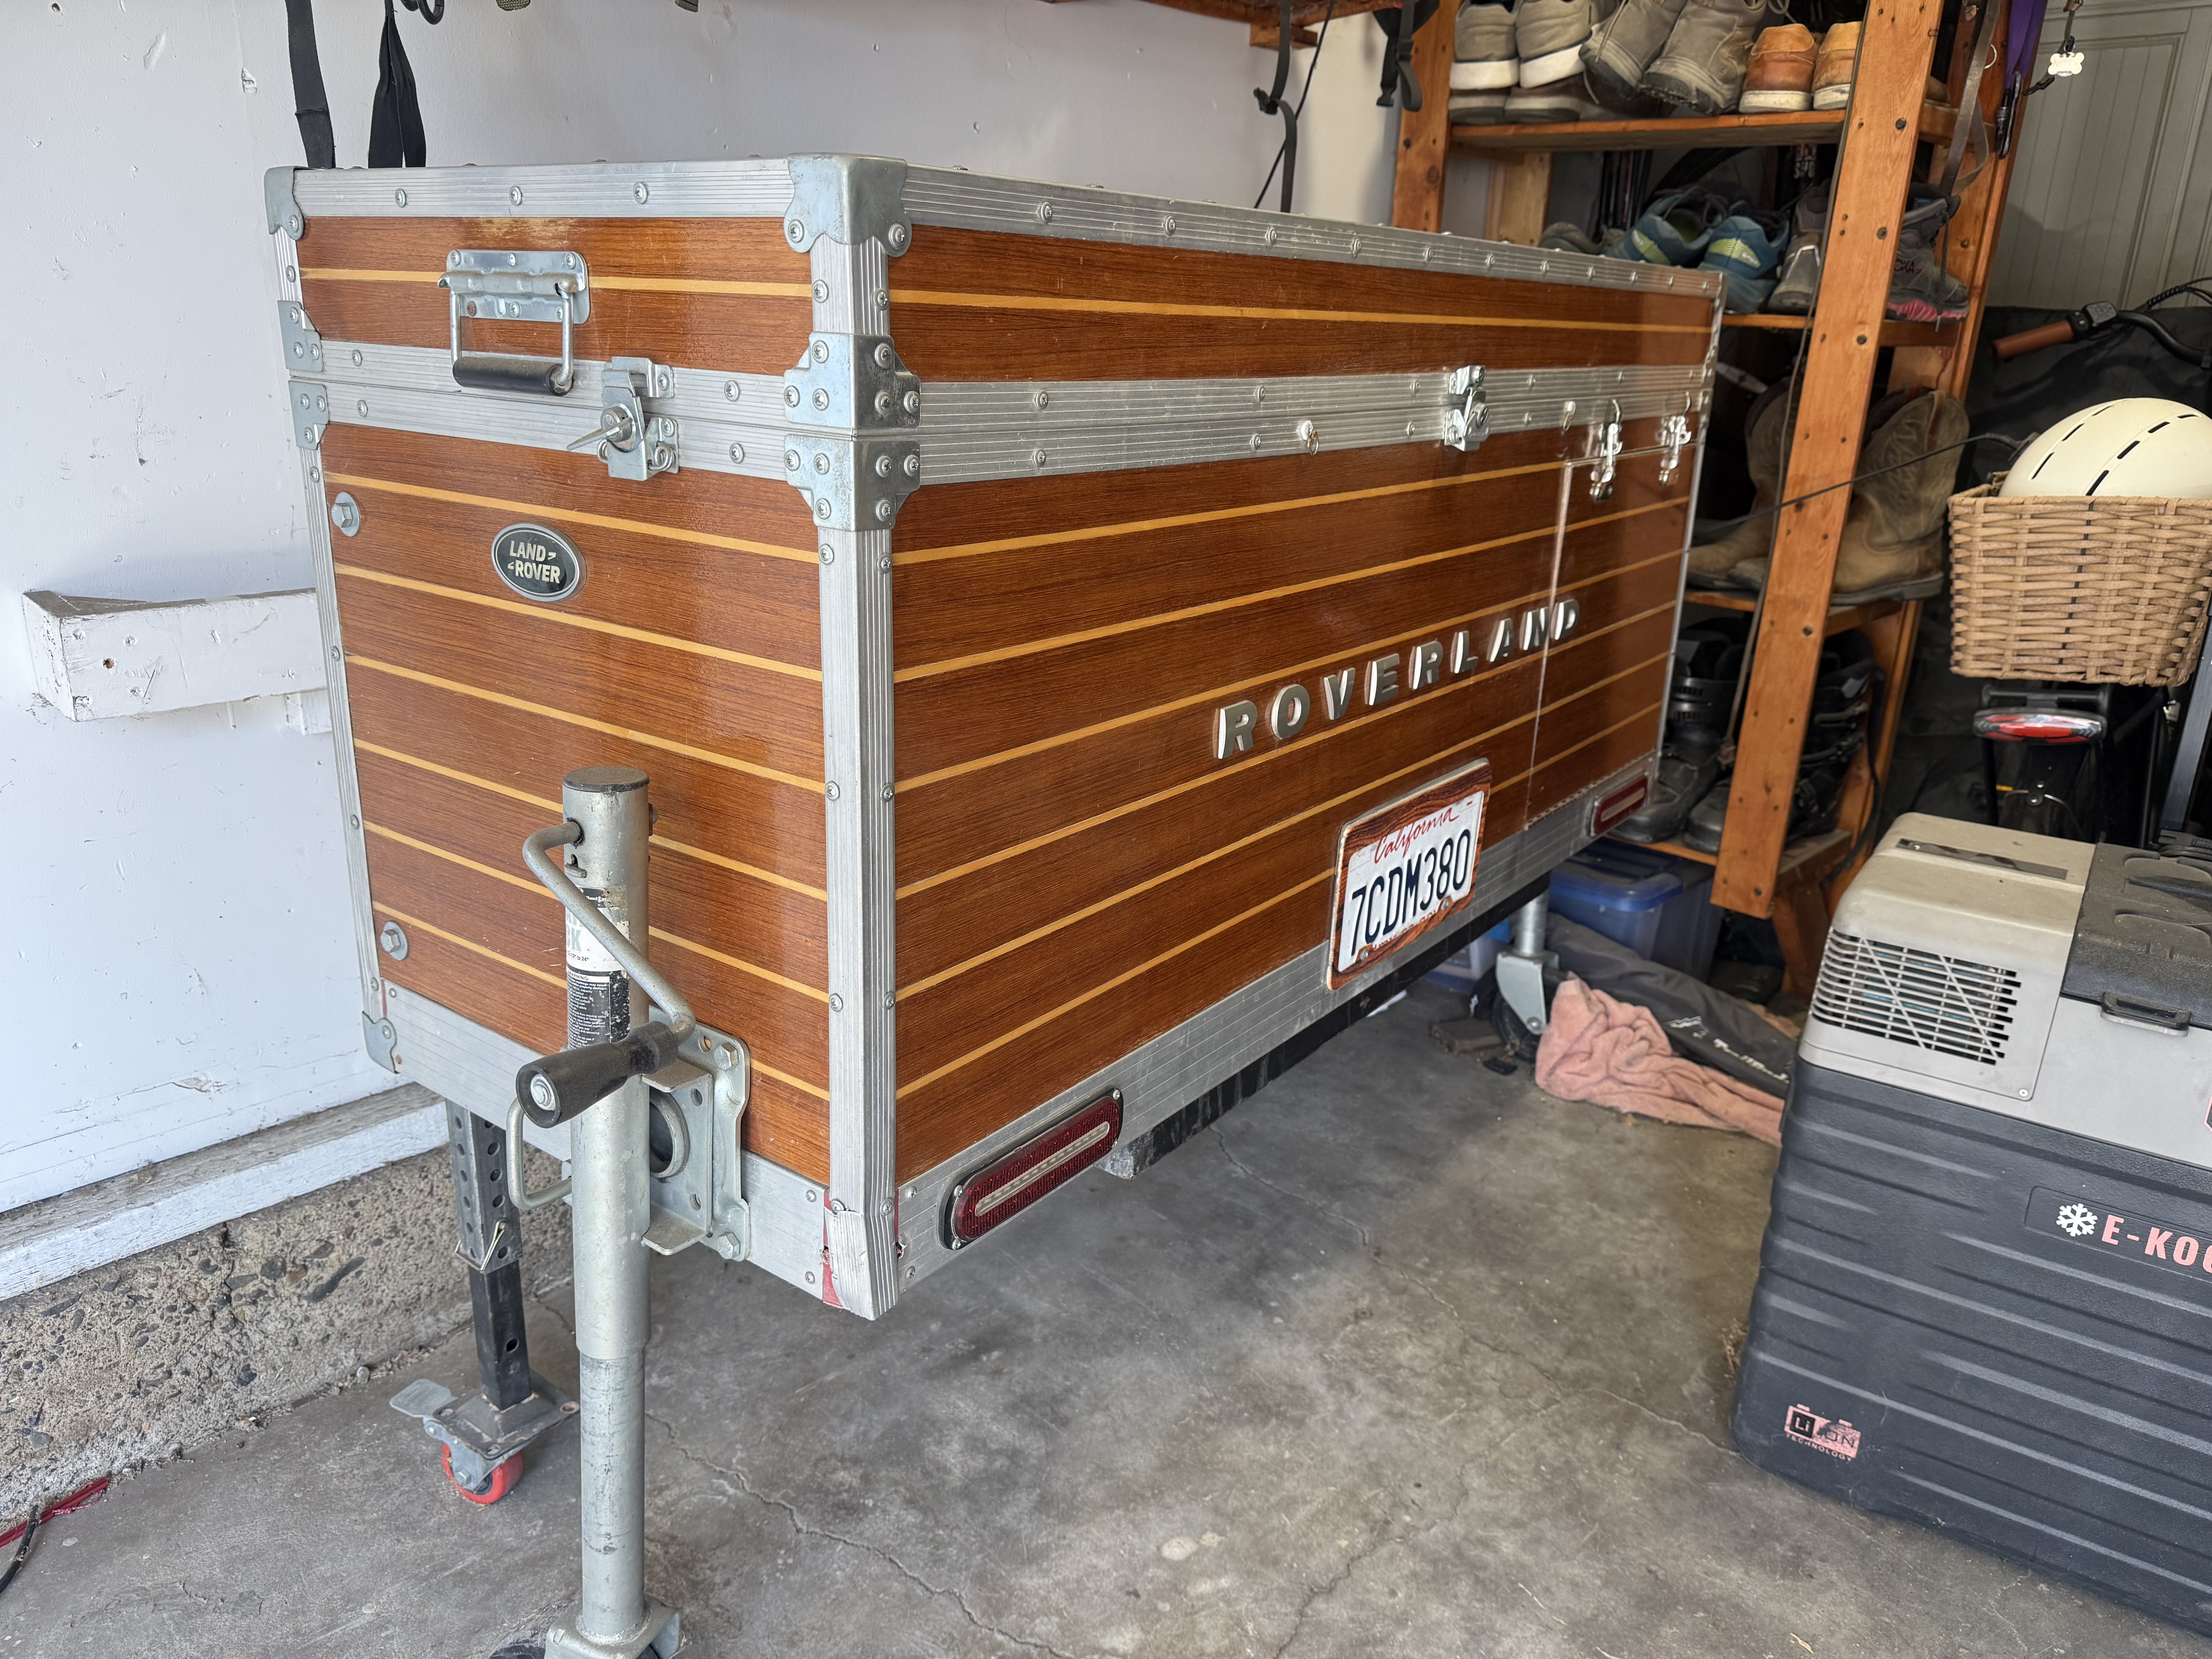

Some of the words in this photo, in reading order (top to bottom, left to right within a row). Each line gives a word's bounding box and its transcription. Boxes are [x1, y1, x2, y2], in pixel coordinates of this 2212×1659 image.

[510, 541, 546, 561] LAND
[515, 560, 560, 584] ROVER
[1215, 599, 1580, 759] ROVERLAND
[1374, 807, 1460, 864] California
[1351, 829, 1471, 956] 7CDM380
[1795, 1417, 1811, 1432] Li
